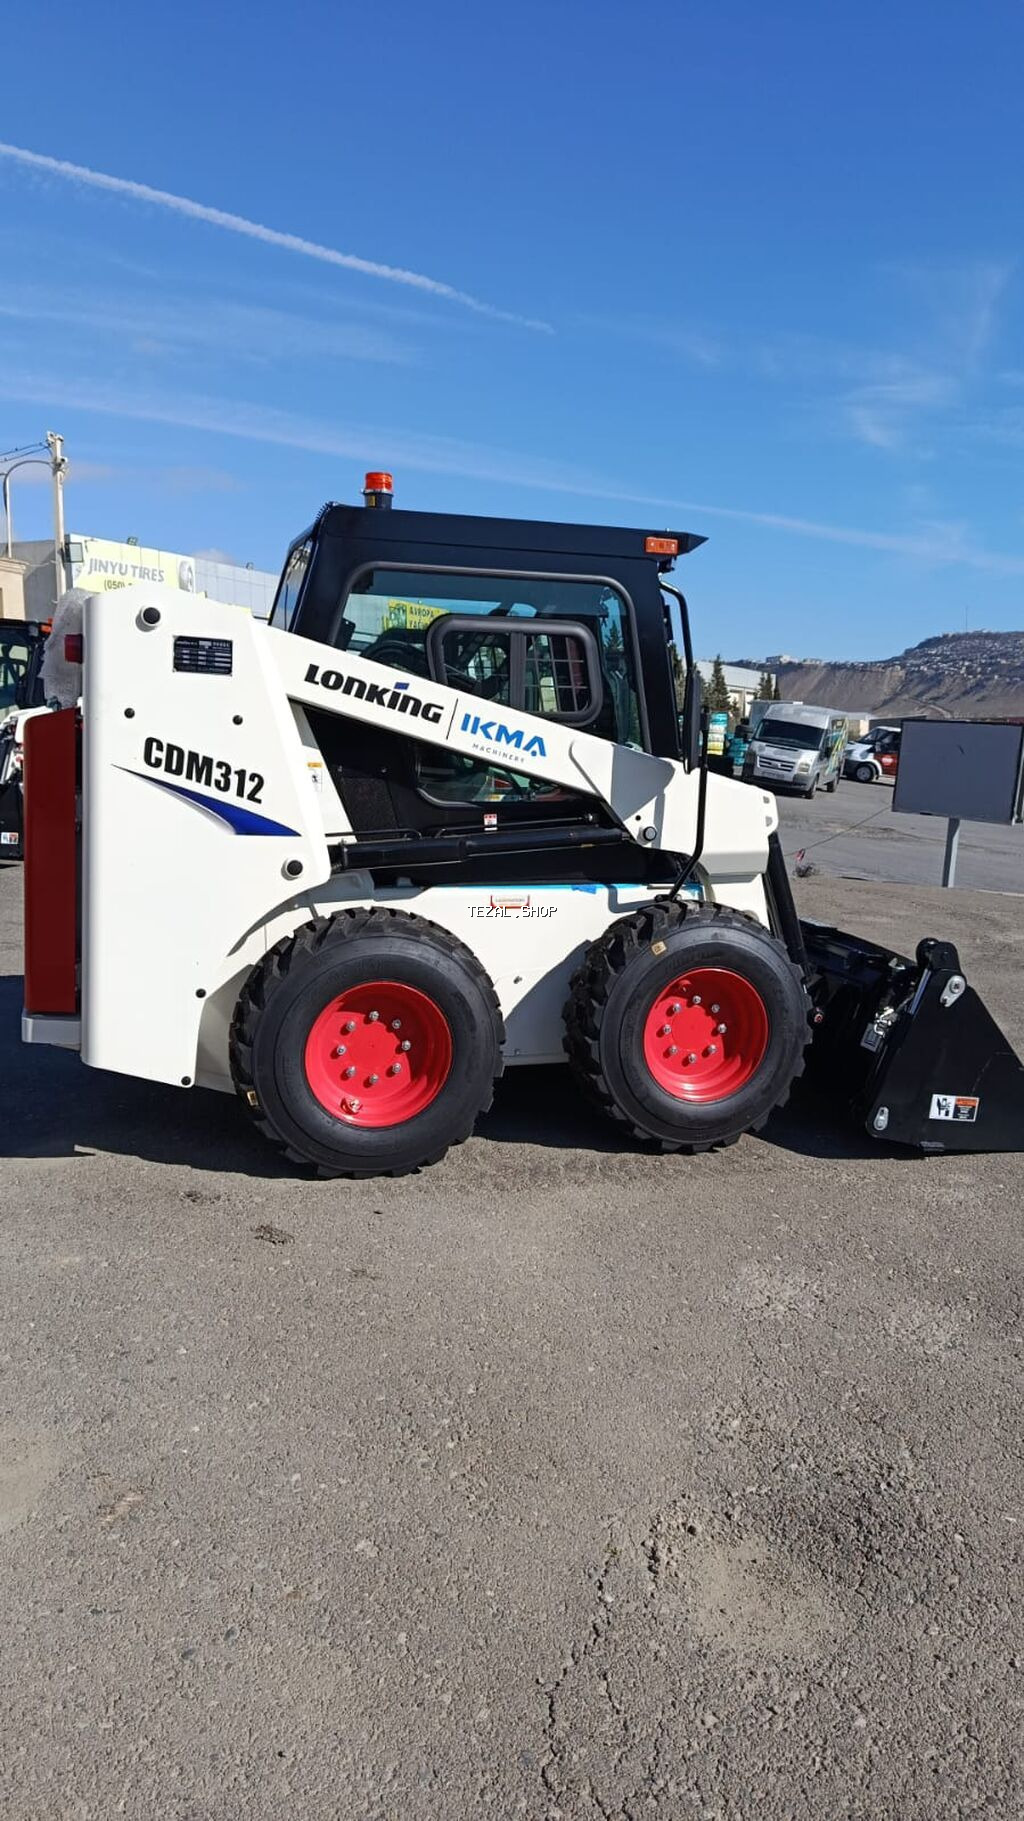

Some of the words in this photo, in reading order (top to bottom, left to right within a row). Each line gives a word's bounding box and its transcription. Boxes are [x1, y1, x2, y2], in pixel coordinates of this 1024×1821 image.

[88, 558, 128, 576] JINYU
[130, 565, 165, 583] TIRES
[304, 663, 444, 724] LONKING
[461, 713, 546, 757] IKMA
[143, 737, 264, 804] CDM312
[472, 743, 525, 763] MACHINERY
